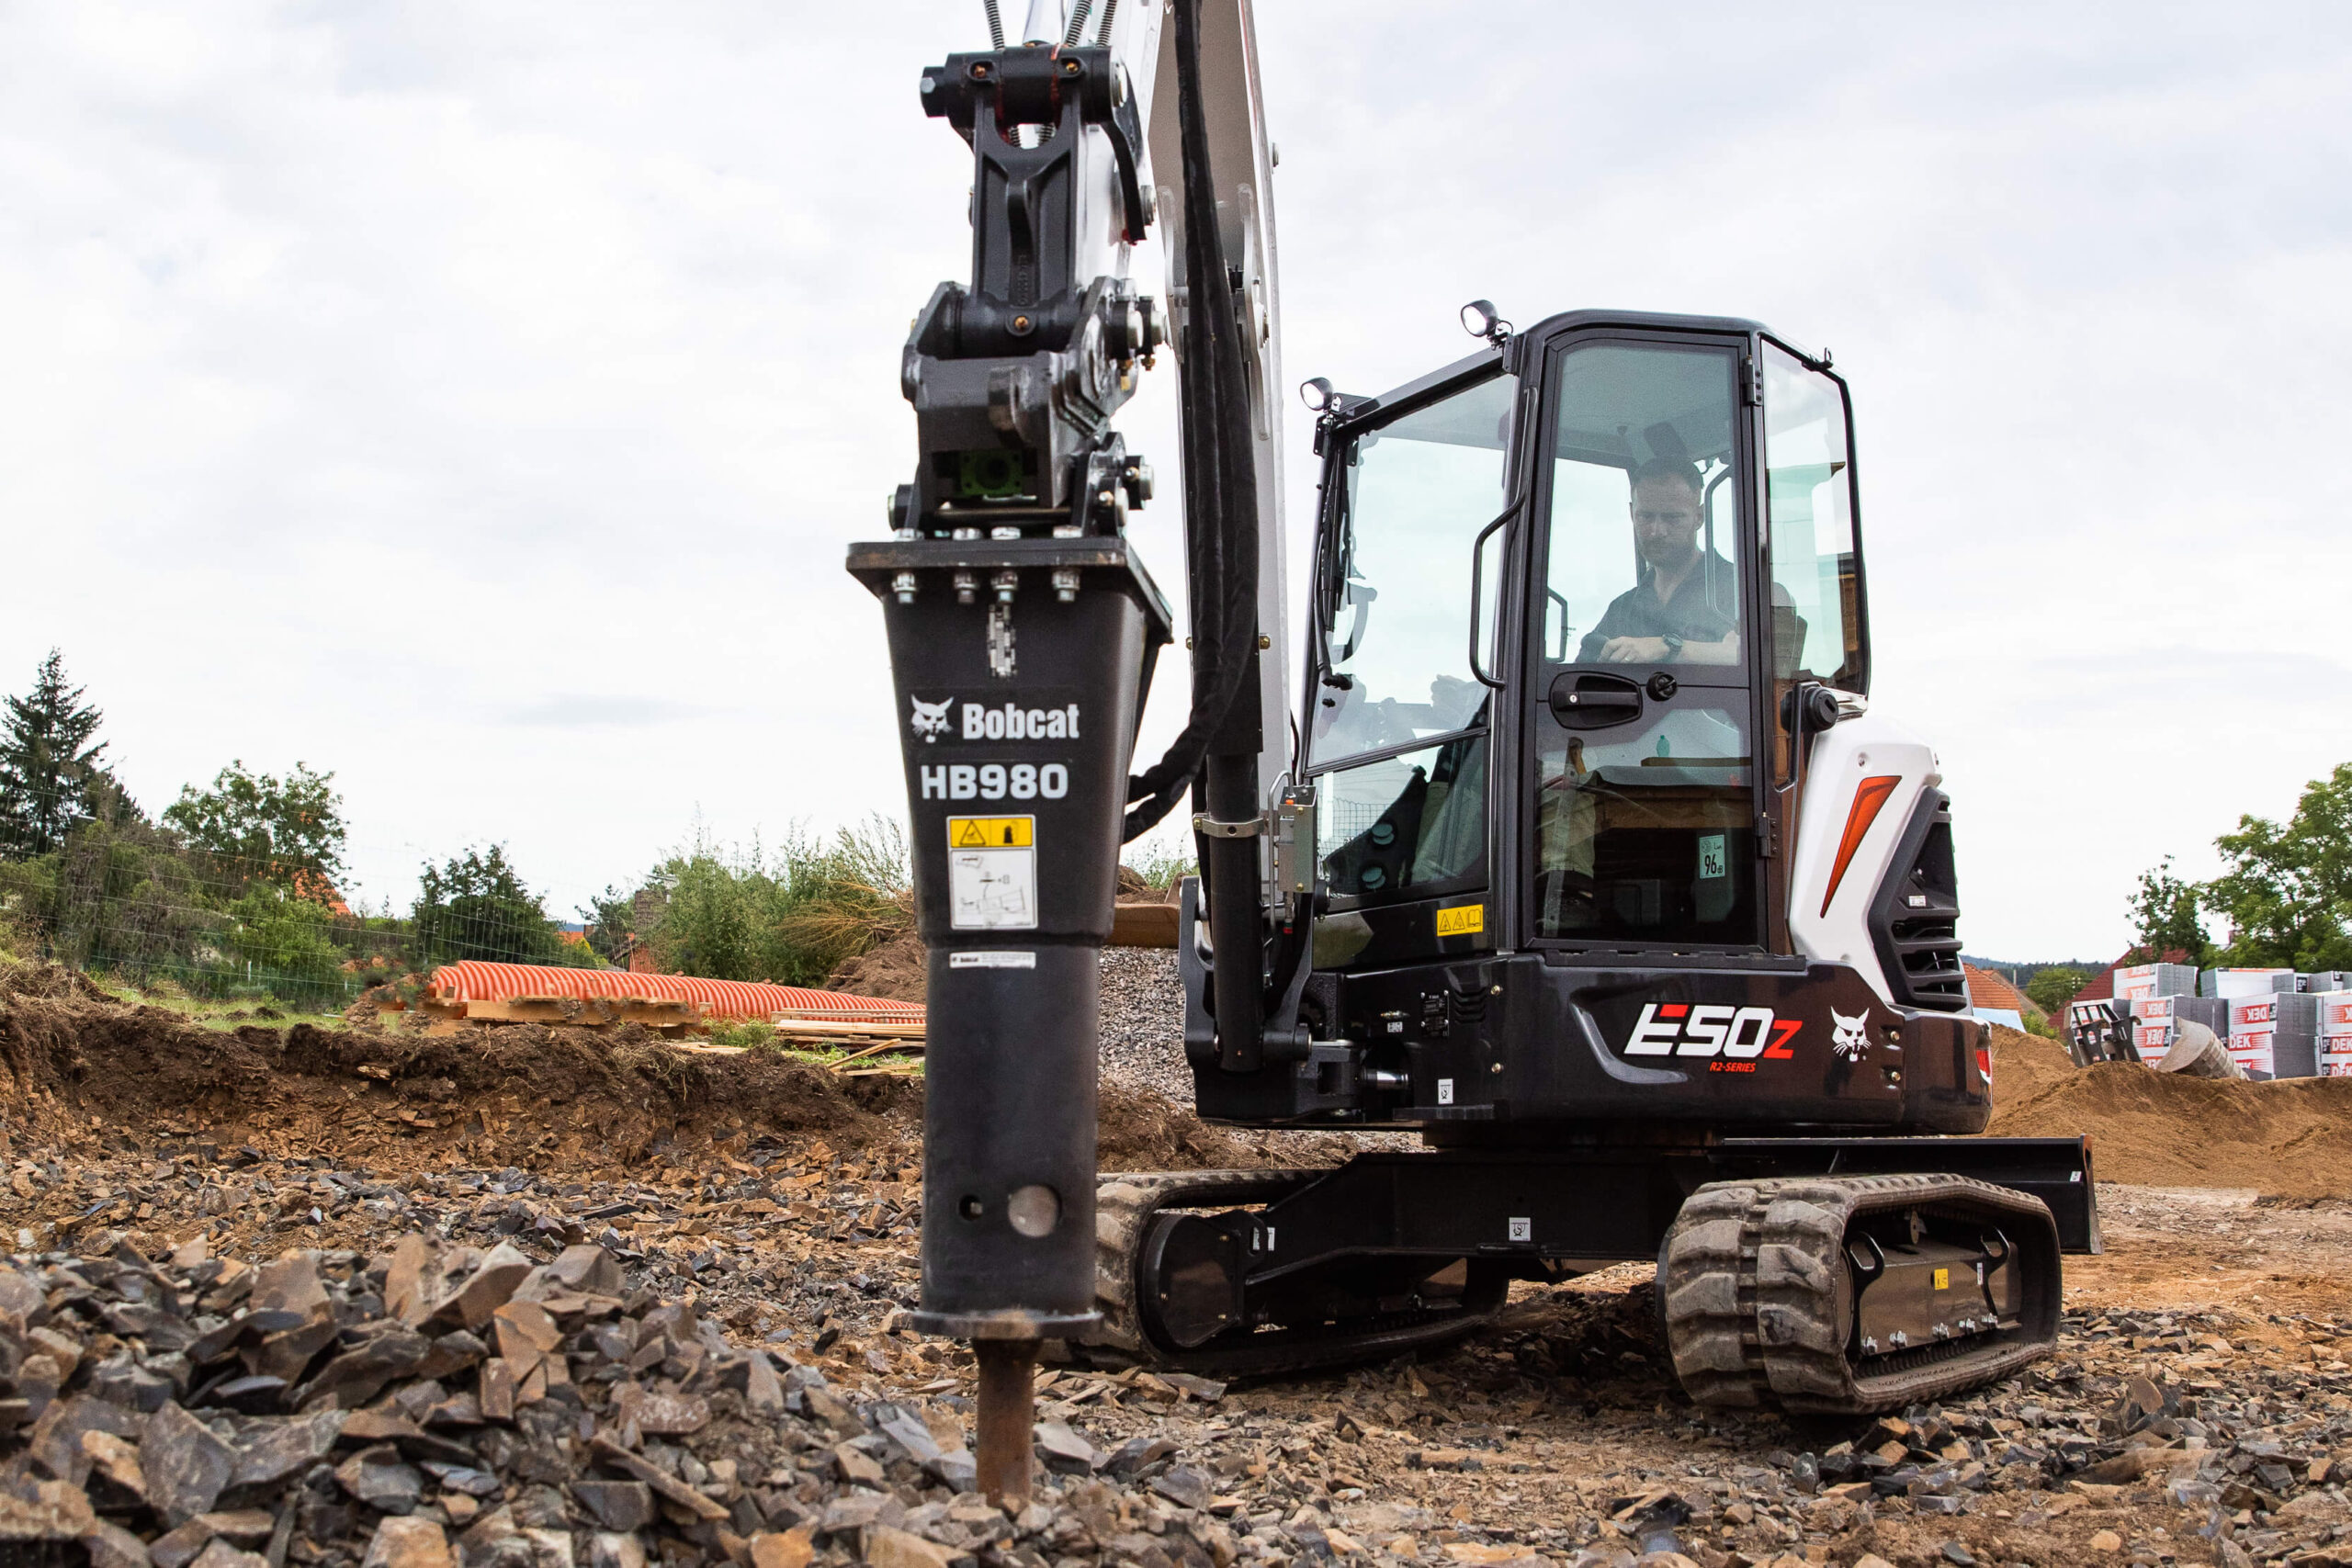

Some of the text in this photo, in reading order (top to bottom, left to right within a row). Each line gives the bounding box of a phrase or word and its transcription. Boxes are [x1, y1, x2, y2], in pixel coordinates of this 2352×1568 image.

[962, 703, 1080, 739] Bobcat
[921, 763, 1069, 800] HB980
[1704, 853, 1717, 874] 96
[2146, 1002, 2164, 1015] DEK
[2247, 1007, 2267, 1021] DEK
[2146, 1028, 2164, 1045] DEK
[2229, 1035, 2252, 1049] DEK
[1709, 1061, 1756, 1073] R2-SERIES
